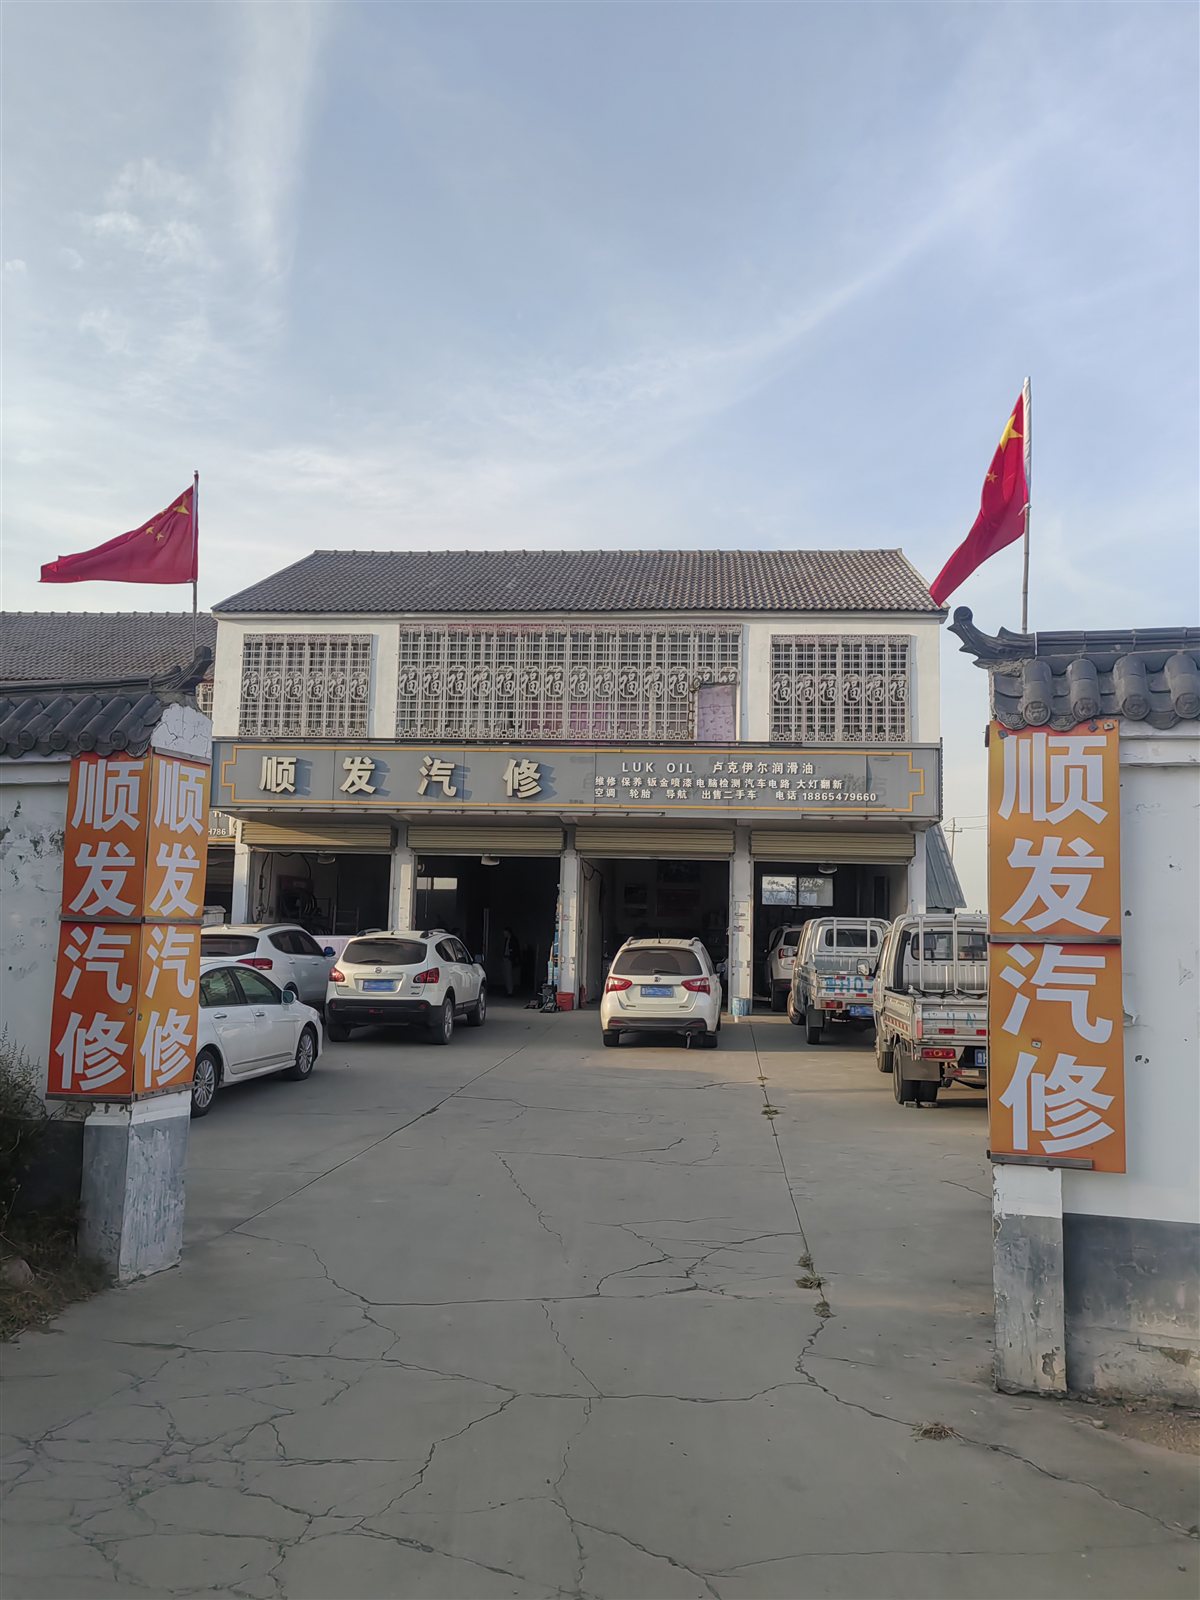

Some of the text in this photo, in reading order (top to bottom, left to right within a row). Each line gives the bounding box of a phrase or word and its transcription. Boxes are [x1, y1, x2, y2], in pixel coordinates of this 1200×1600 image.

[259, 755, 543, 799] 顺发汽修
[594, 776, 843, 790] 维修 保养 钣金喷漆 电脑检测 汽车电路 大灯翻新
[621, 761, 815, 775] LUK OIL 卢克伊尔润滑油
[594, 788, 877, 802] 空调 轮胎 导航 出售二手车 电话 18865479660
[54, 759, 144, 1091] 顺发汽修
[139, 759, 206, 1088] 顺发汽修
[998, 732, 1116, 1155] 顺发汽修
